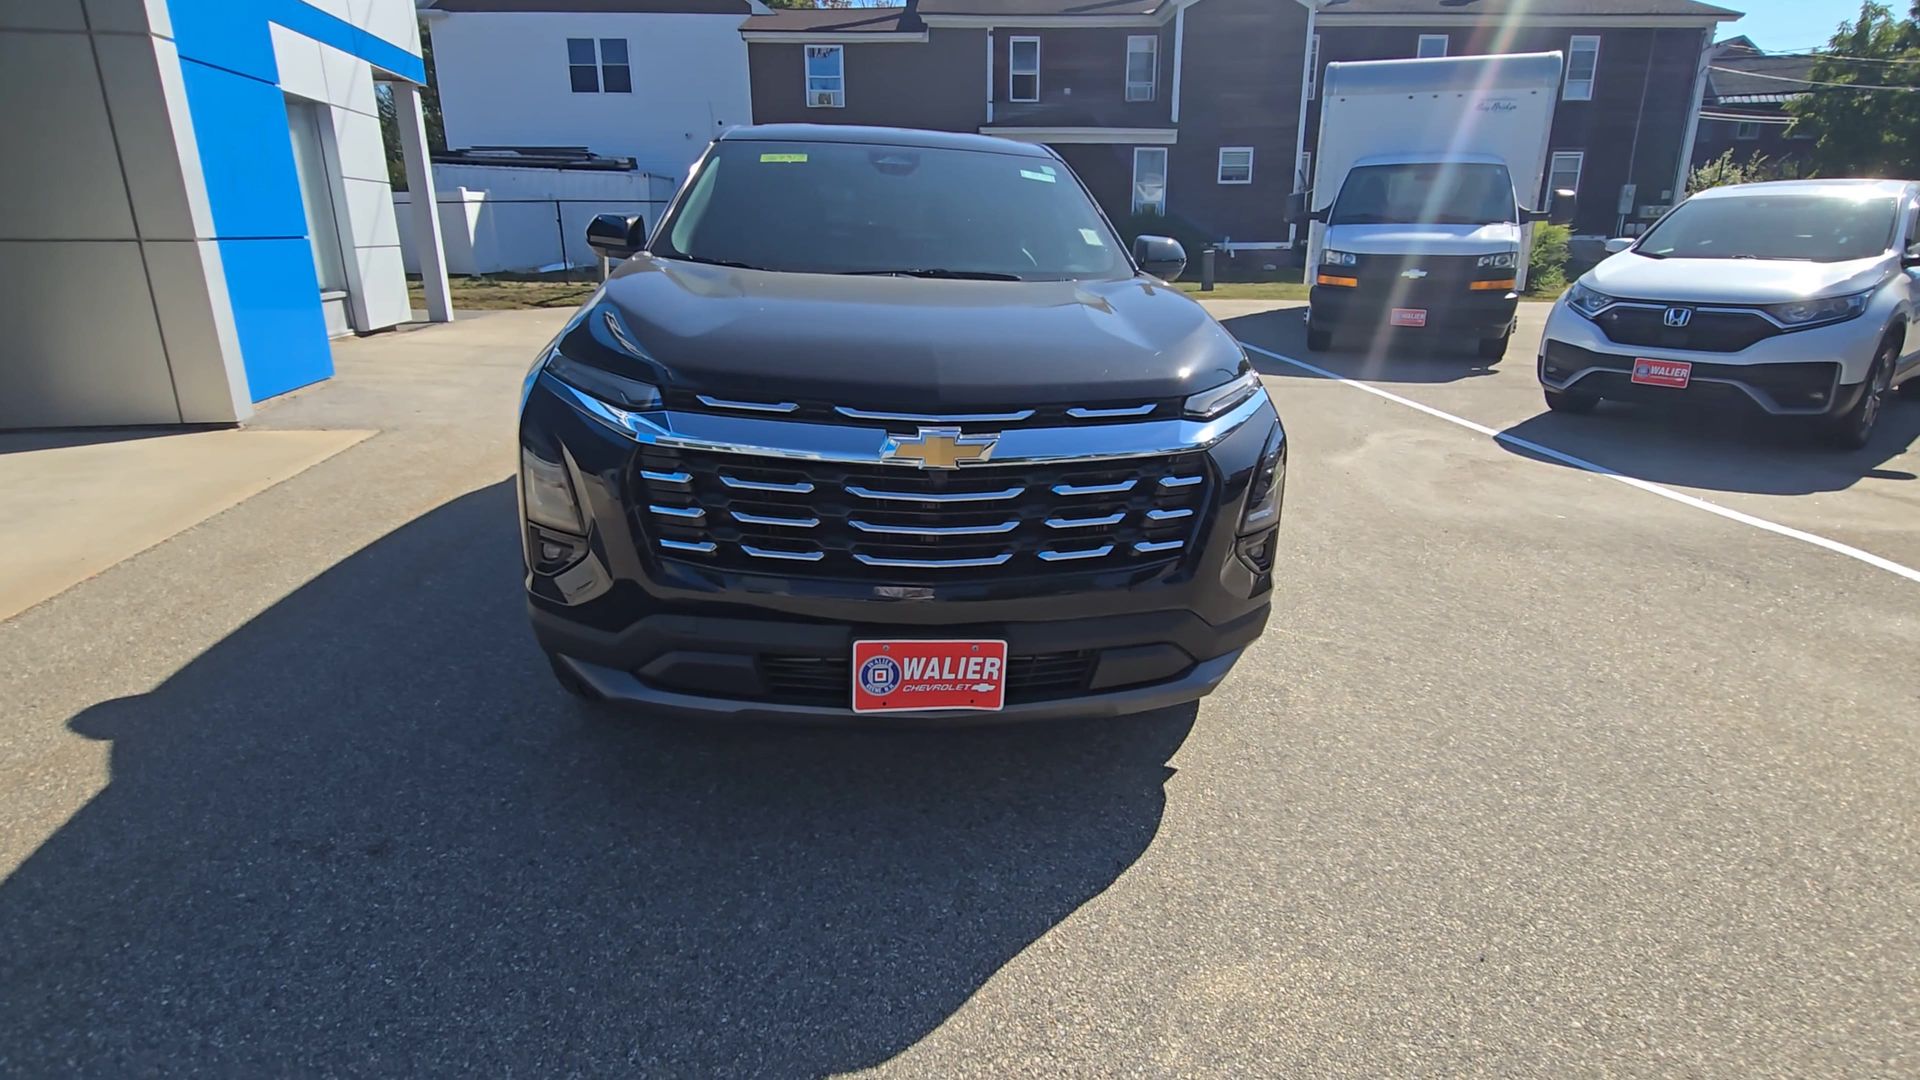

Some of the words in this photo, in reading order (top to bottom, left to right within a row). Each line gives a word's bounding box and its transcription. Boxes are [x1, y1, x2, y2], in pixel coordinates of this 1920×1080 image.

[1650, 365, 1688, 378] WALIER
[903, 657, 1001, 681] WALIER
[903, 683, 971, 692] CHEVROLET
